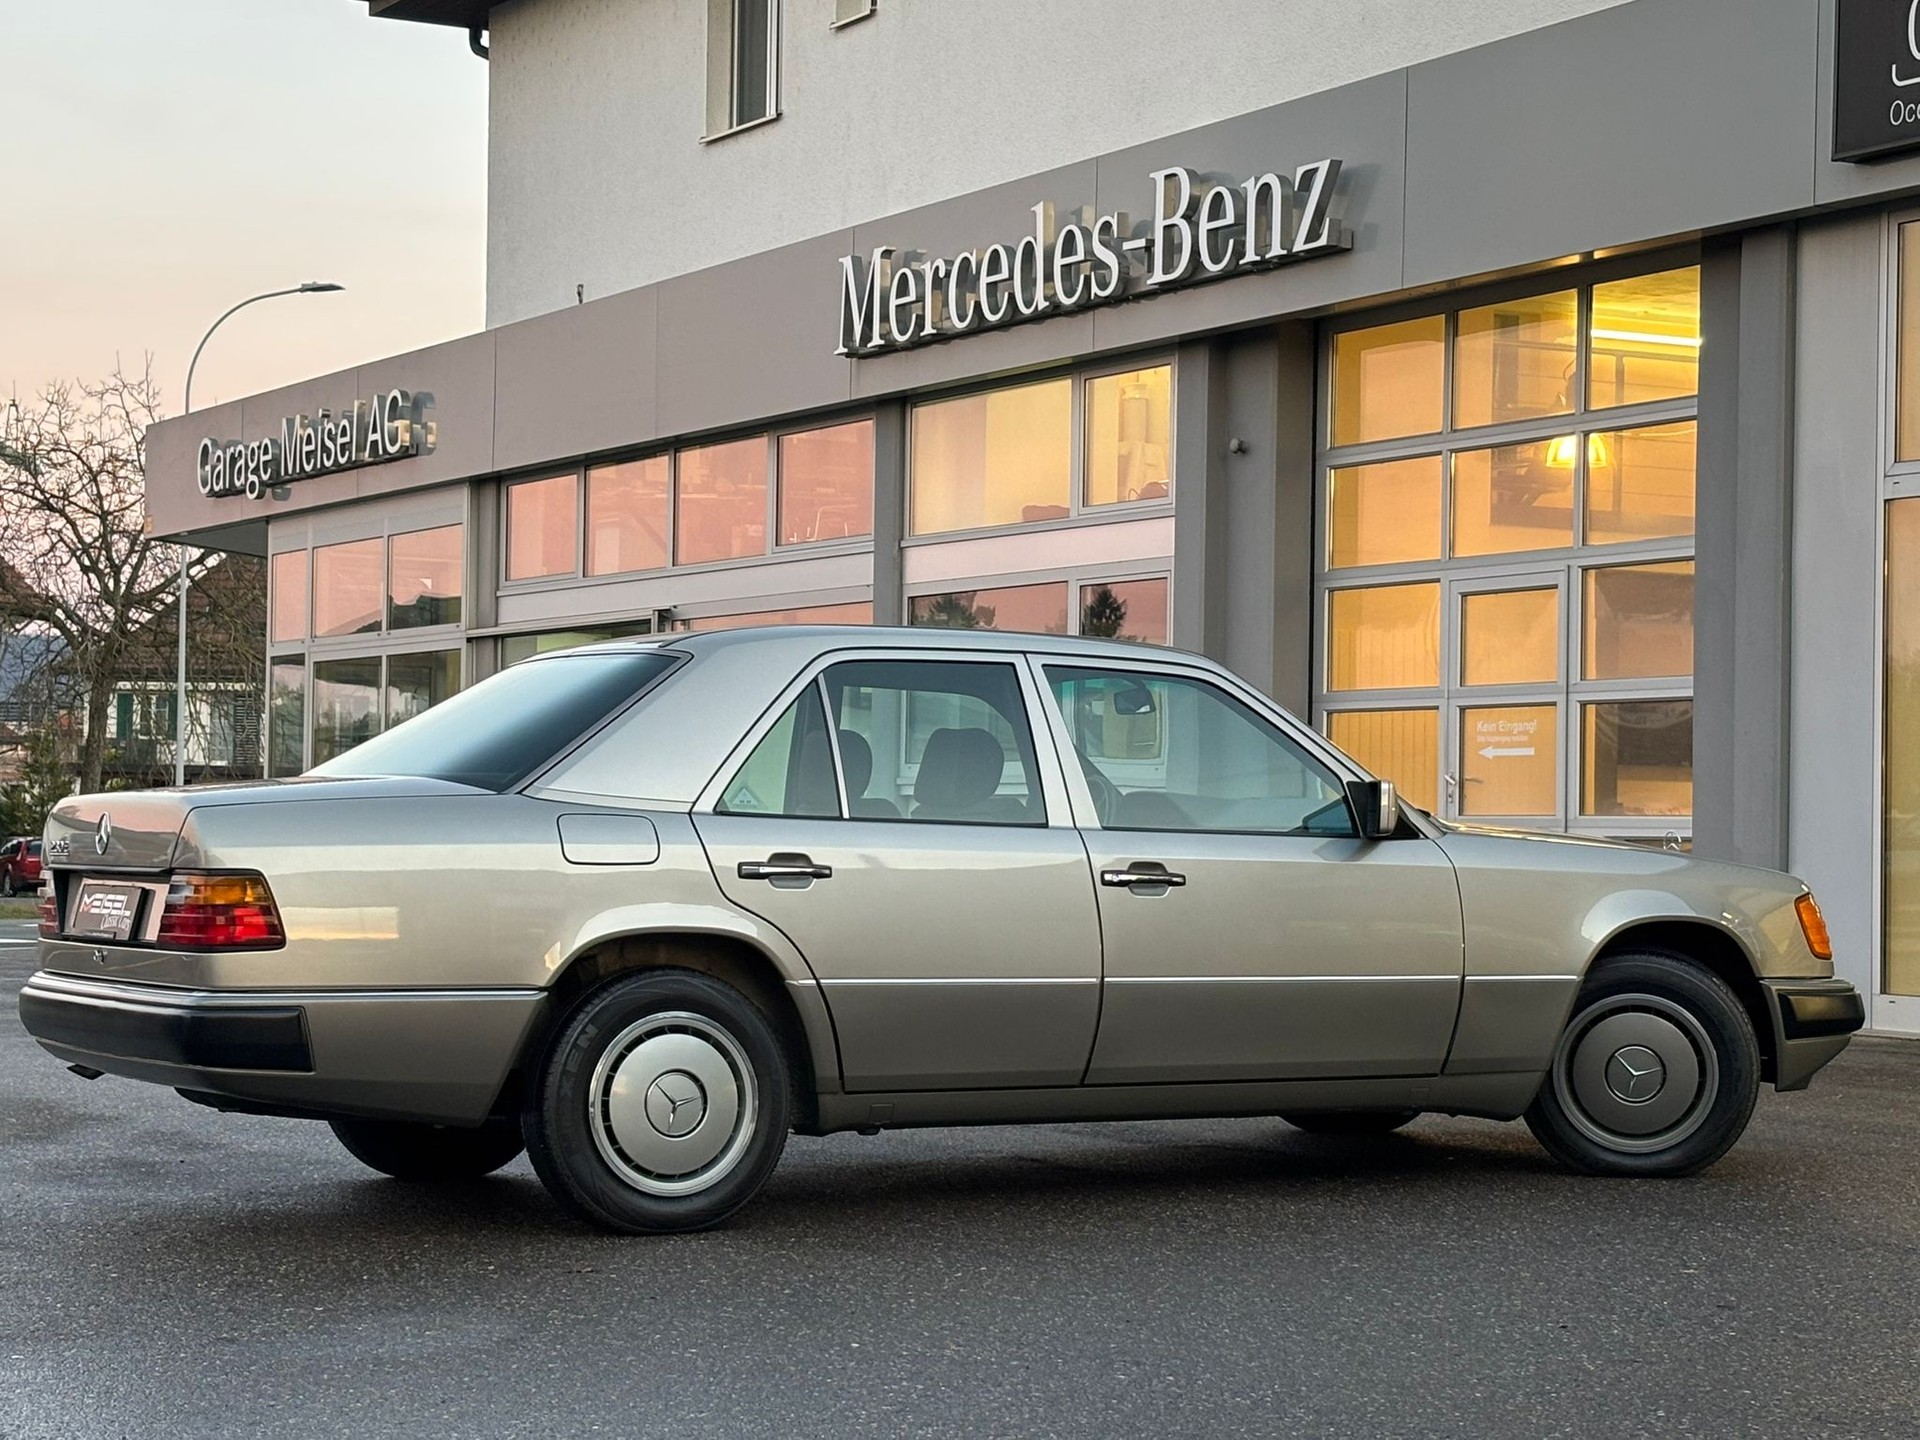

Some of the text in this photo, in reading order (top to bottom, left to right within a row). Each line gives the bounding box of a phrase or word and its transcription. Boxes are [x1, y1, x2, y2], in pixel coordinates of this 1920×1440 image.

[834, 158, 1346, 356] Mercedes-Benz
[197, 388, 407, 500] Garage Meisel AG
[1477, 719, 1537, 734] Kein Eingang!
